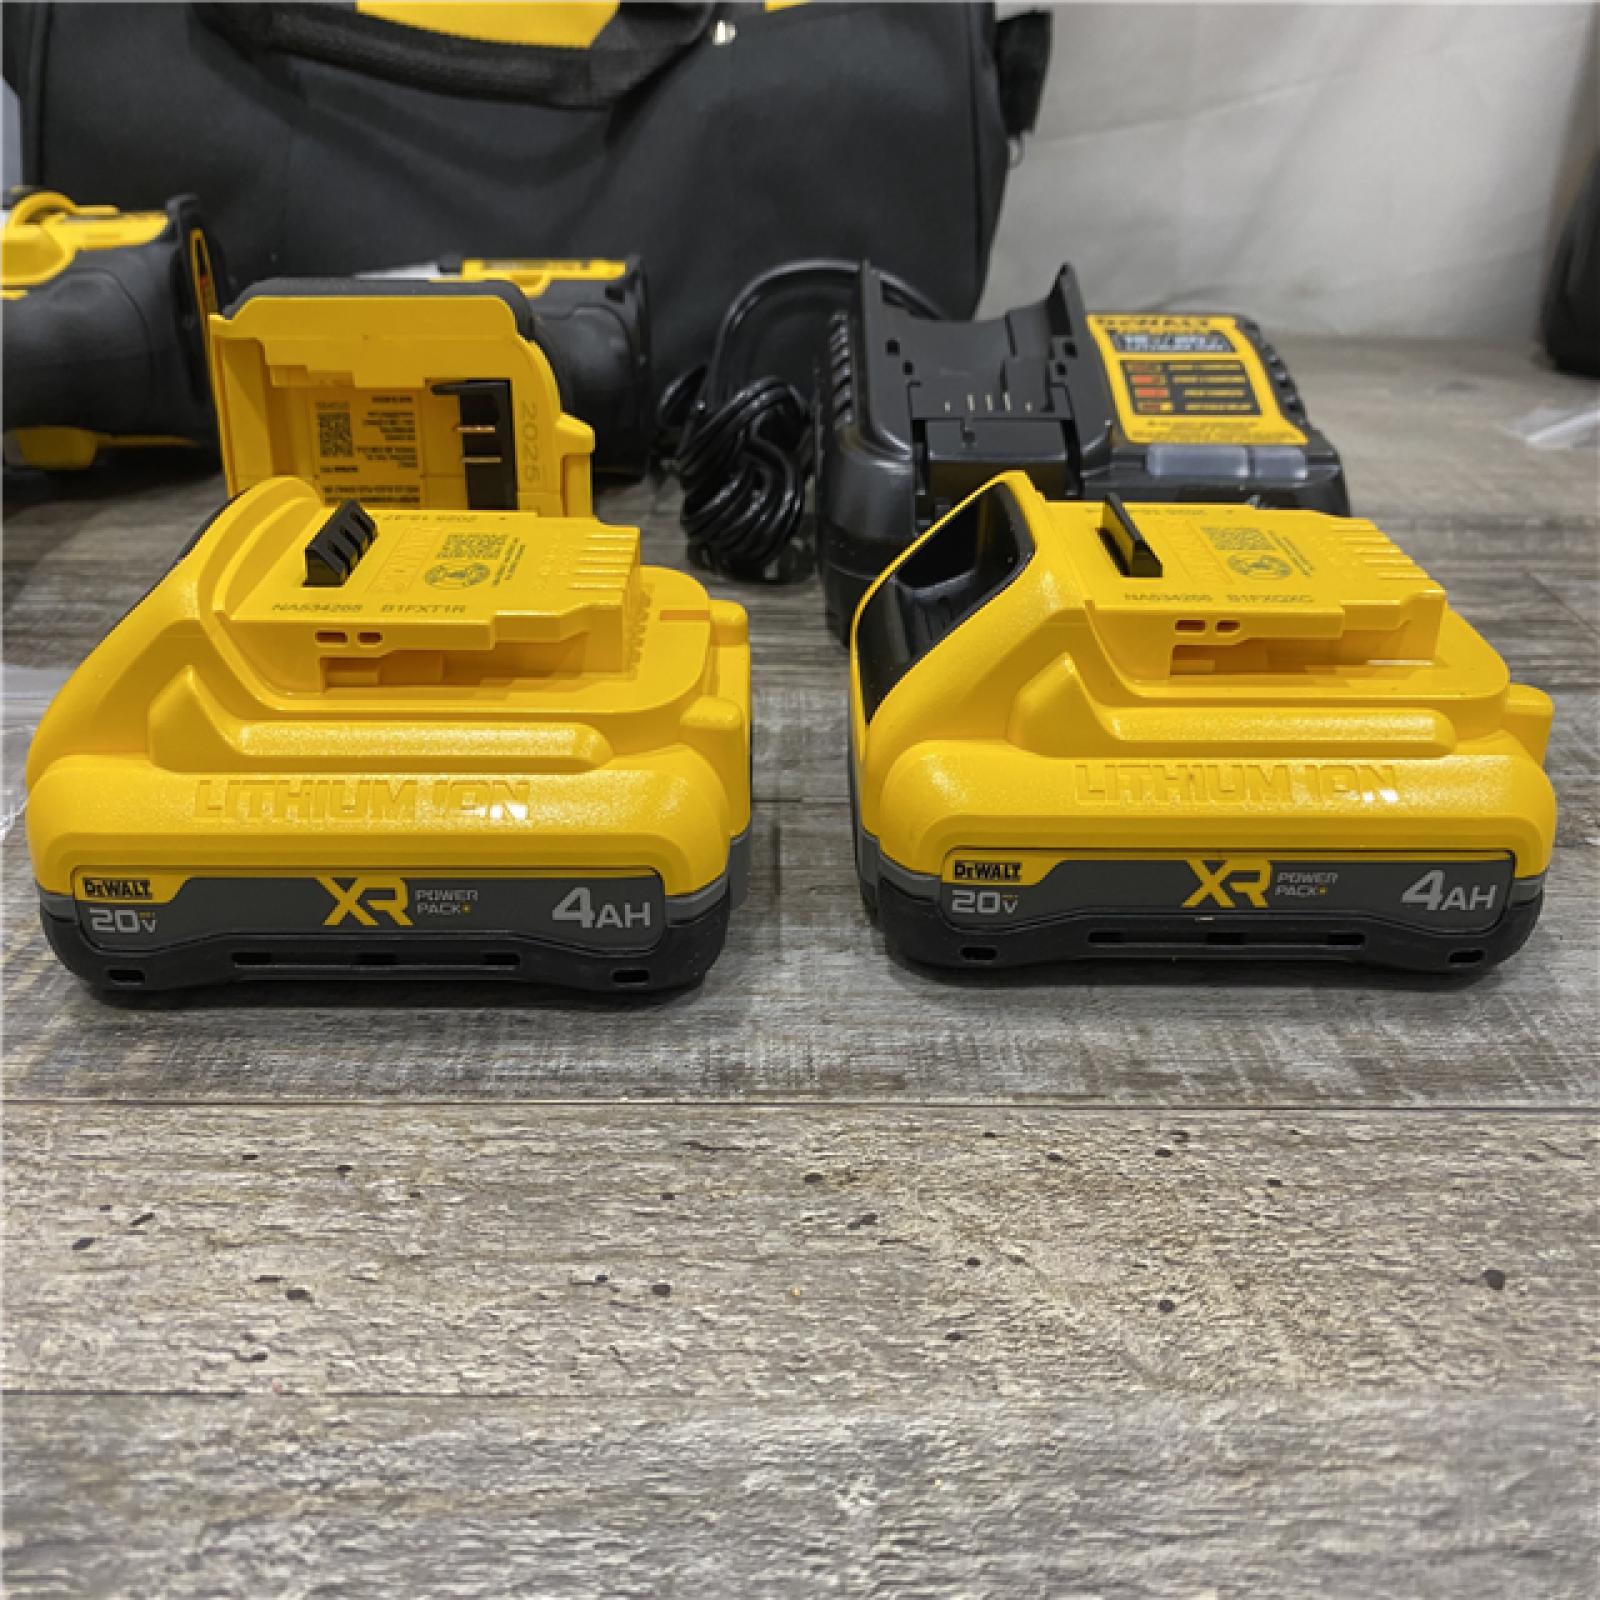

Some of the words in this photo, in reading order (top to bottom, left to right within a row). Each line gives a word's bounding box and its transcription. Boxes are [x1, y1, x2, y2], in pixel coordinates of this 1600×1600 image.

[521, 401, 538, 482] 2025
[195, 779, 417, 819] LITHIUM
[432, 779, 530, 820] ION
[1075, 764, 1291, 803] LITHIUM
[1301, 764, 1398, 804] ION
[415, 889, 478, 901] POWER
[1181, 859, 1272, 909] XR
[1277, 872, 1339, 884] POWER
[314, 876, 414, 926] XR
